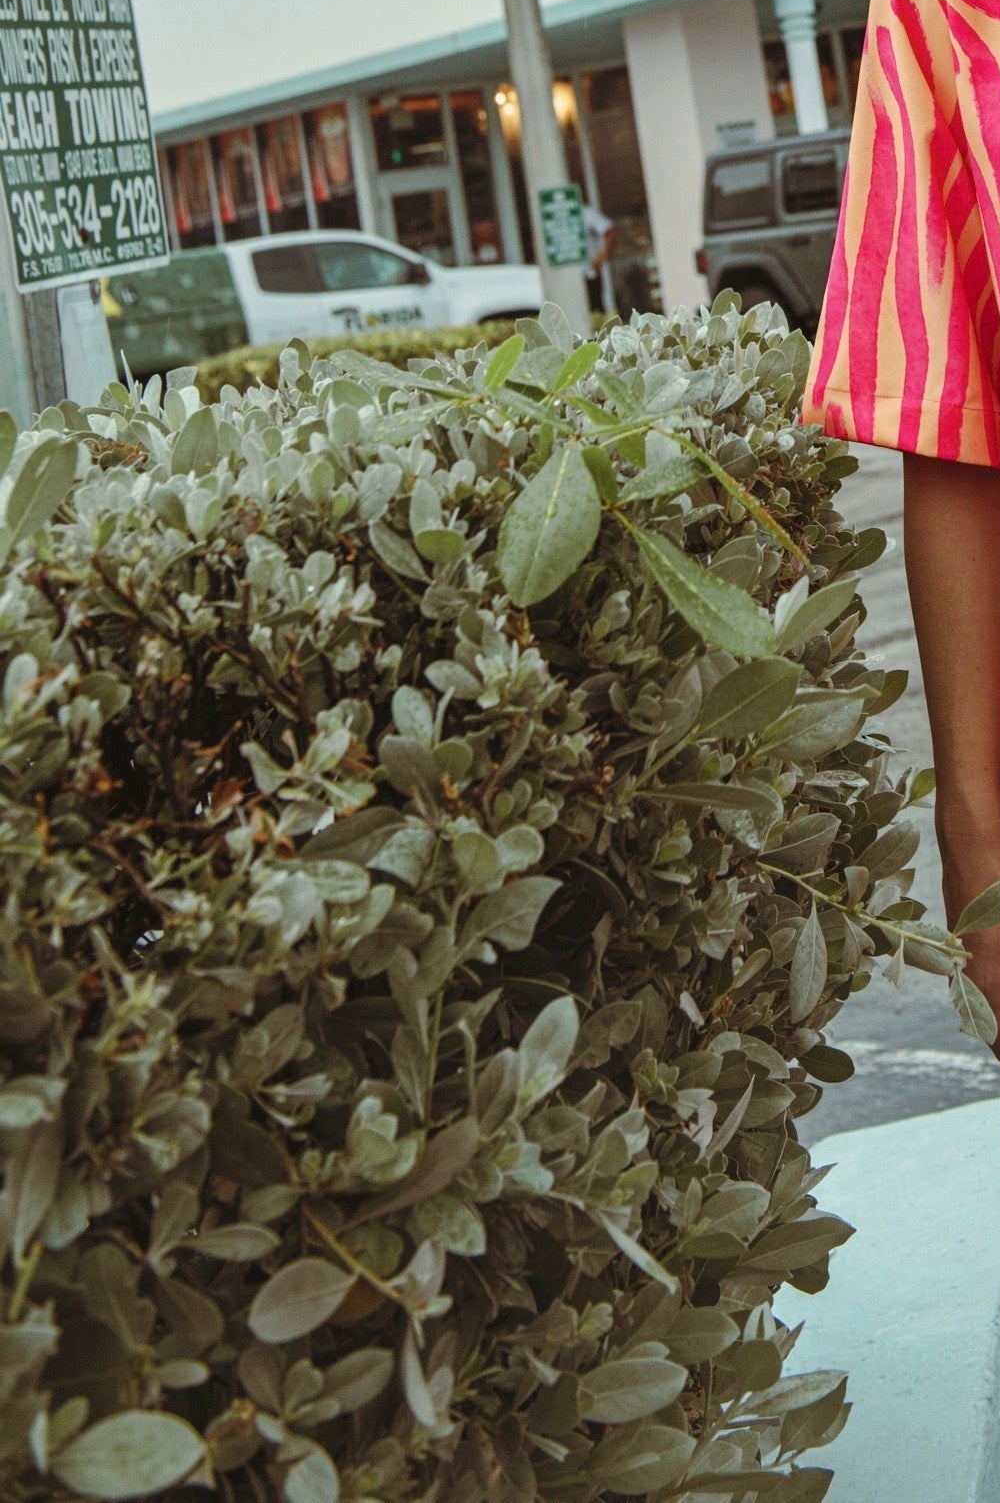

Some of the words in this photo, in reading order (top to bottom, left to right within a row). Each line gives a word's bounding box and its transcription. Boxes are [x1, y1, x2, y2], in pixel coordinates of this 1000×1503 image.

[47, 27, 80, 84] RISK
[89, 29, 139, 82] EXPENSE
[64, 85, 150, 146] TOWING
[11, 175, 161, 257] 305-534-2128
